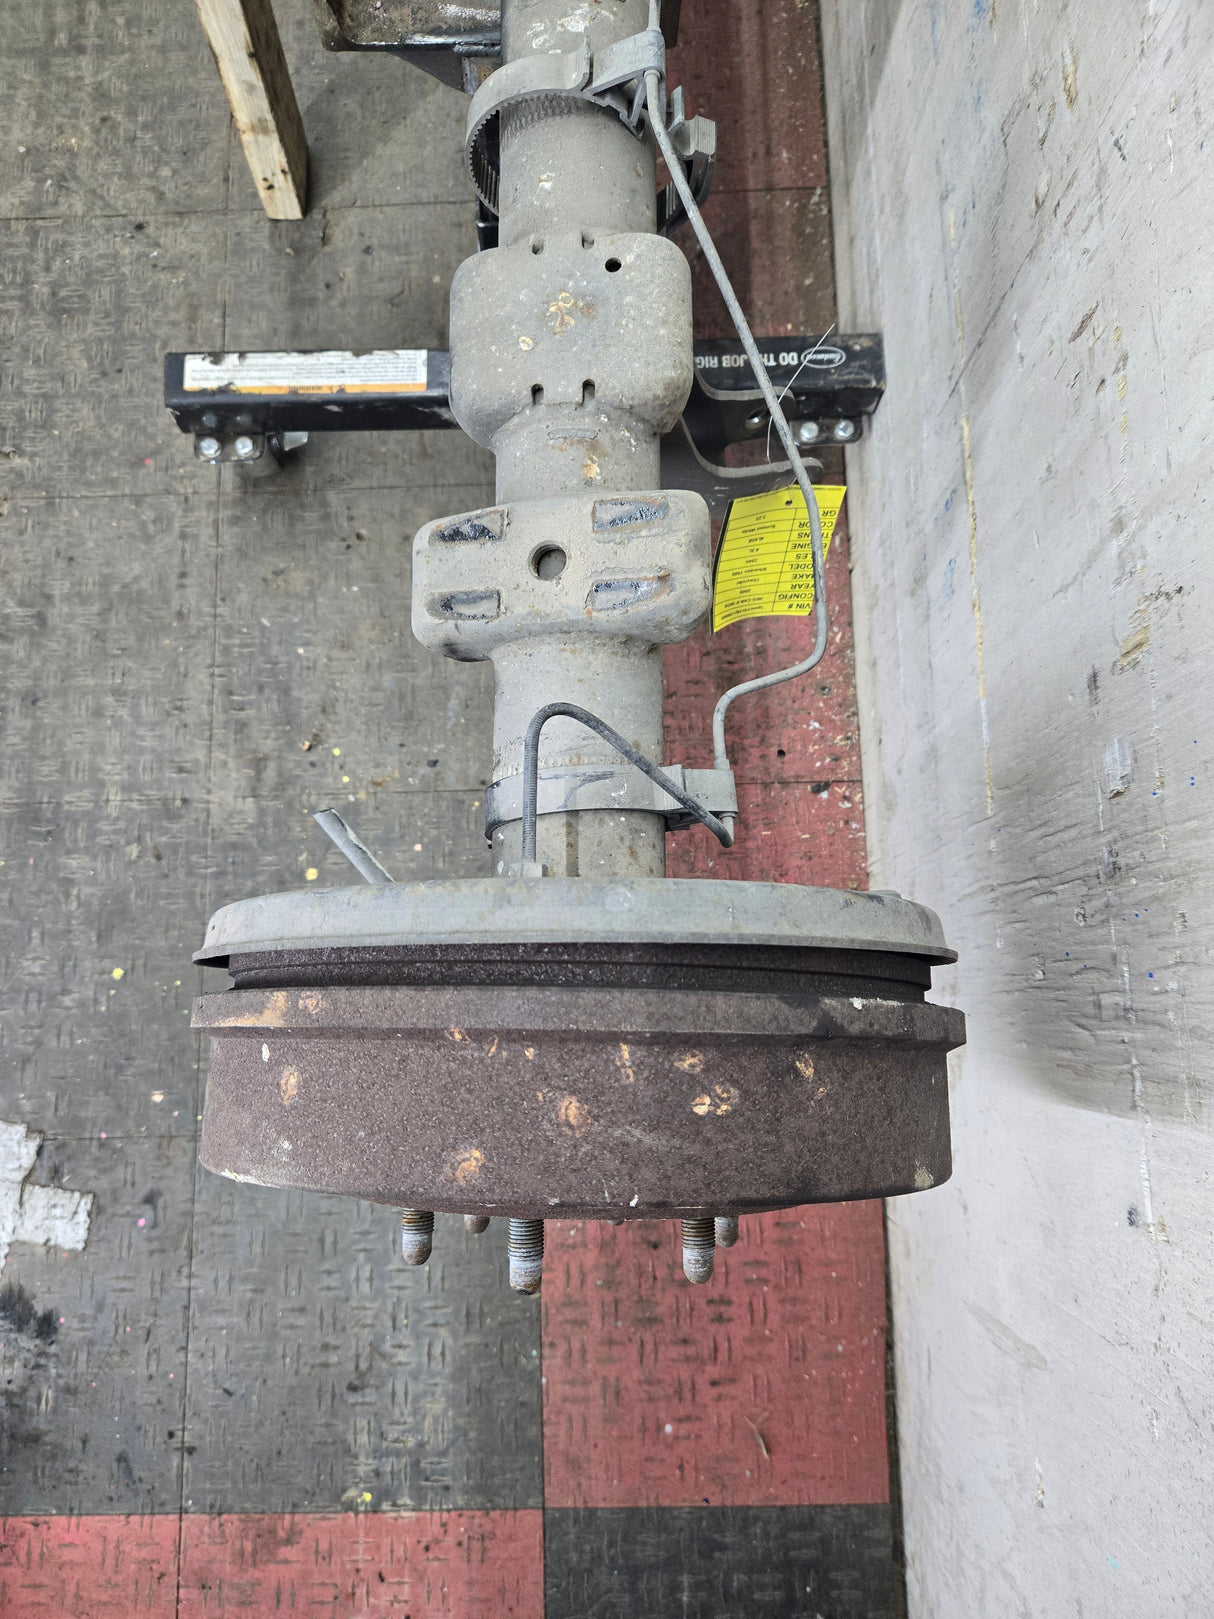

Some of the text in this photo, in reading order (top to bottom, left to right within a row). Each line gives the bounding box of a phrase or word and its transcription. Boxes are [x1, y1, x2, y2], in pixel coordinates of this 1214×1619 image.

[693, 352, 798, 368] DO TH JOB RIG
